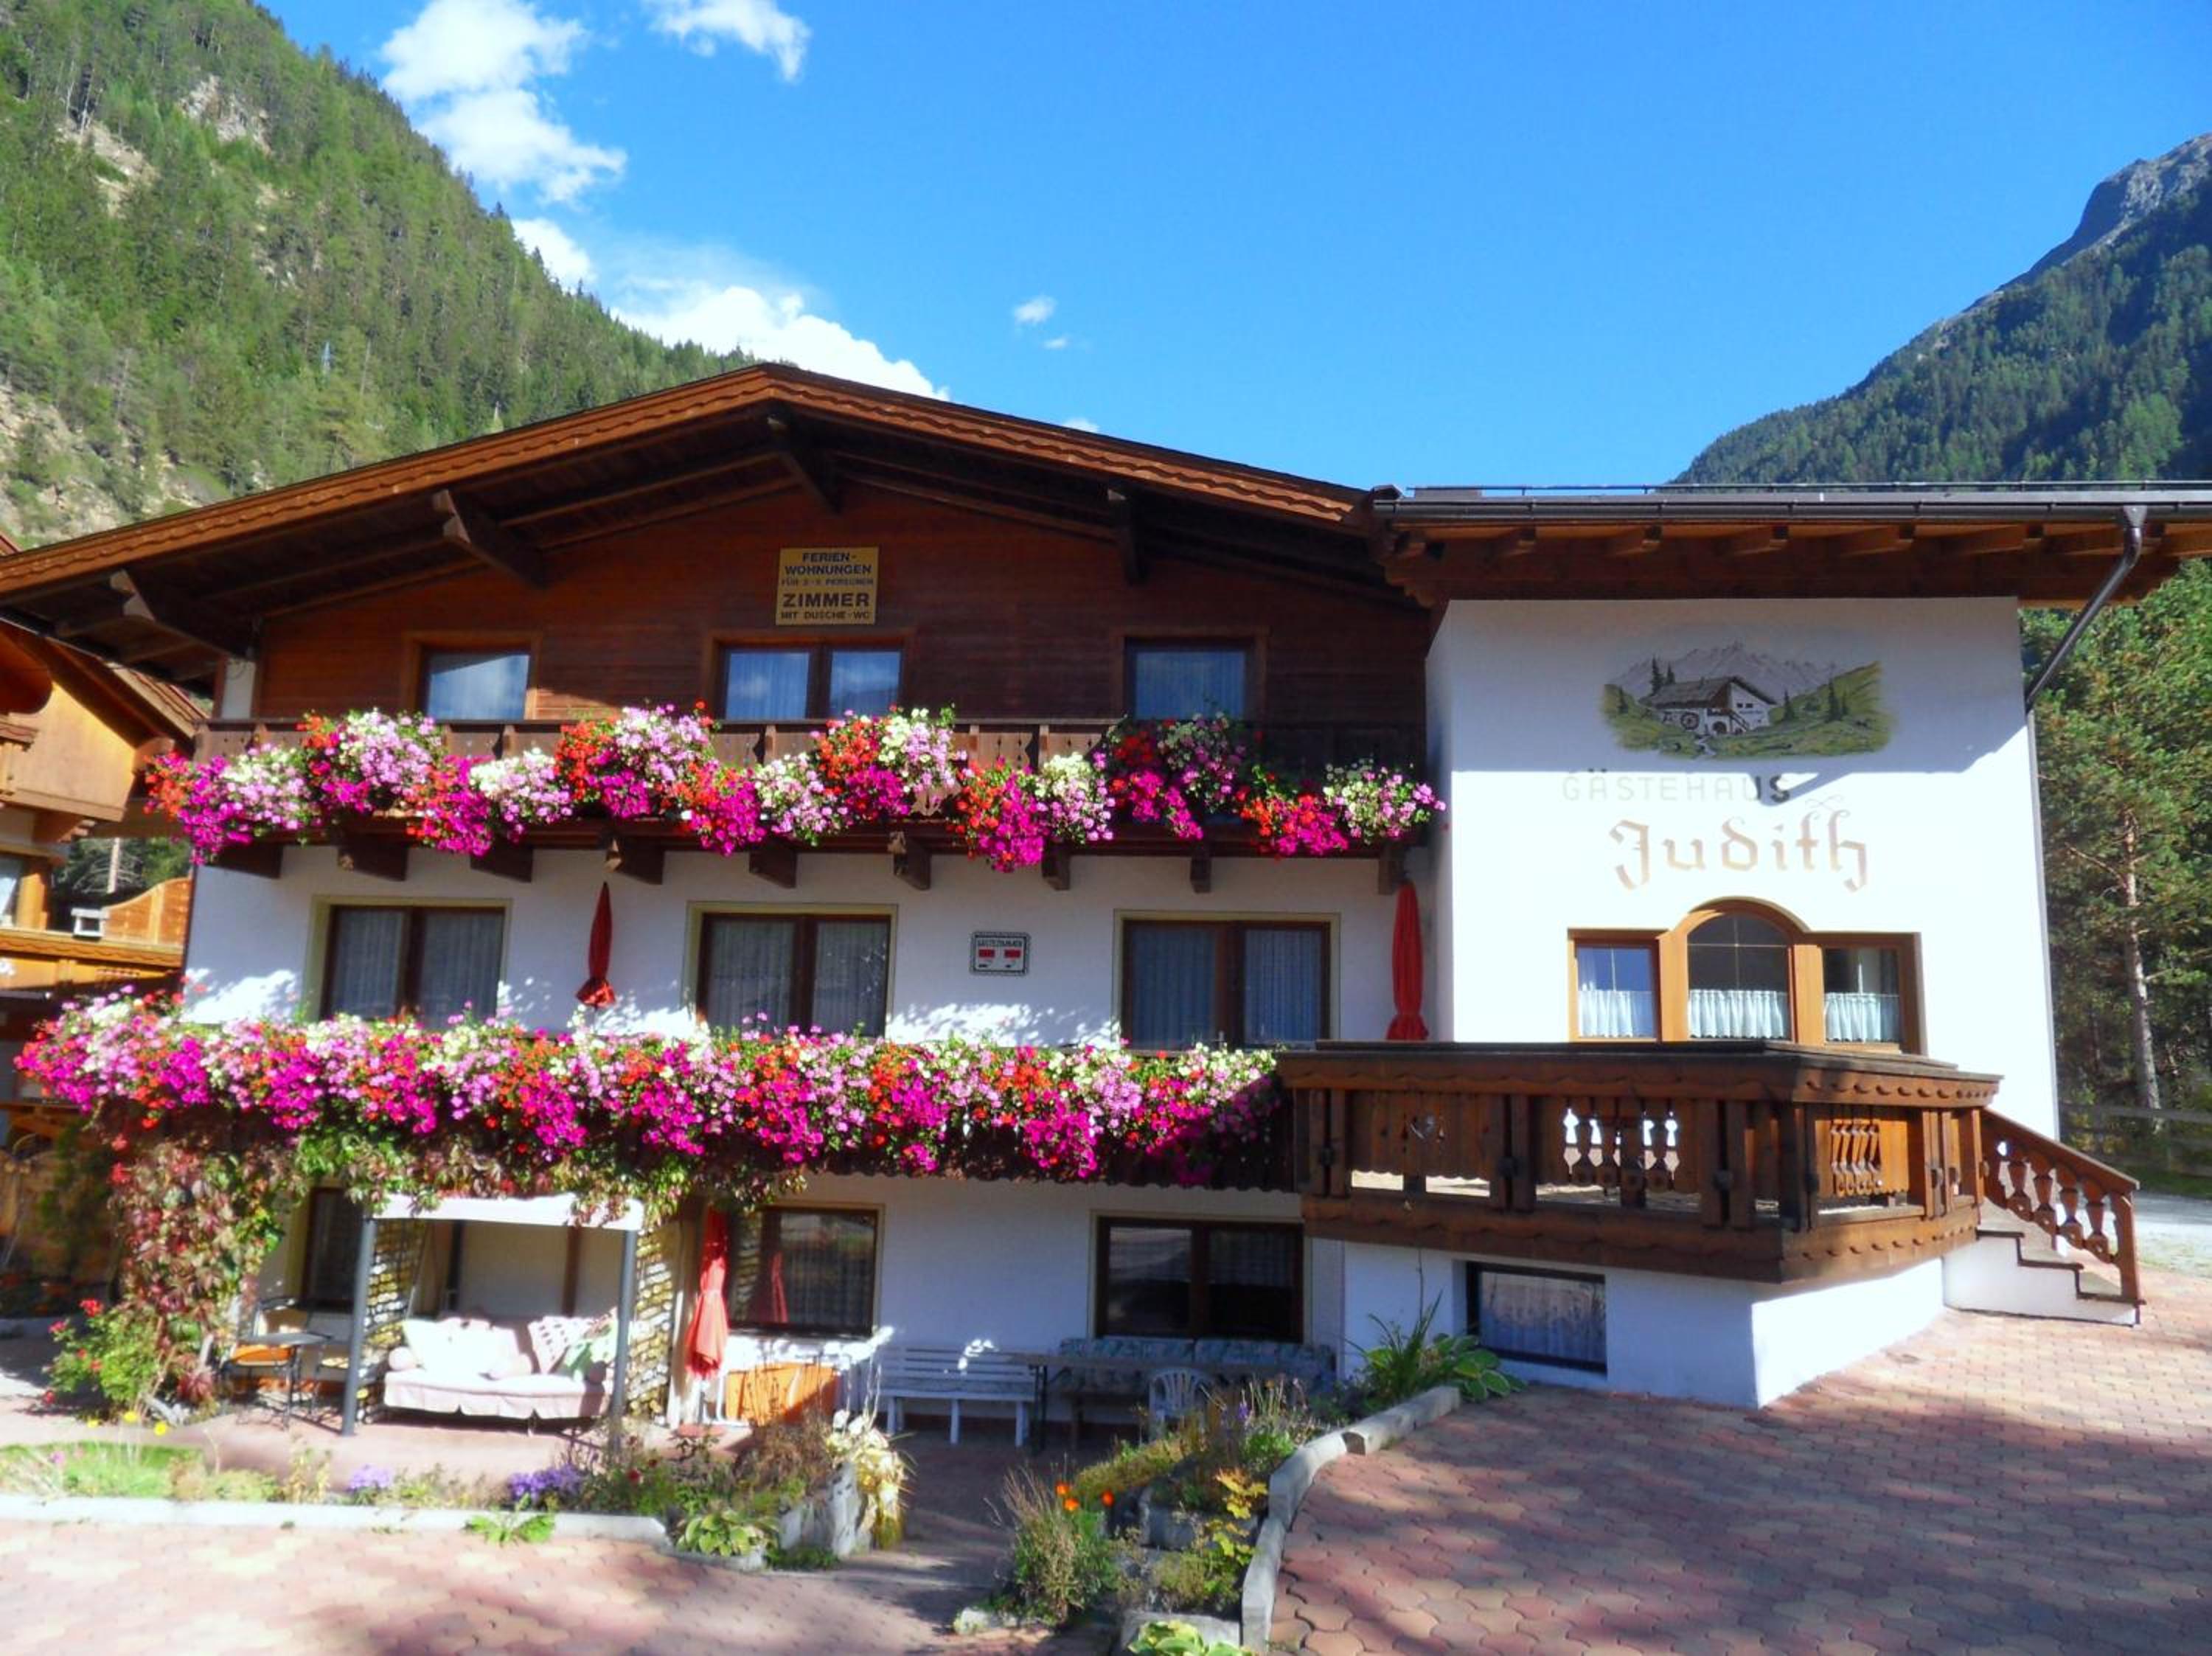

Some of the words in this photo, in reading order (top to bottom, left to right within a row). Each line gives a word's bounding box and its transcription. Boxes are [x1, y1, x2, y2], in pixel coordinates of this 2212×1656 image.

[802, 552, 858, 563] FERIEN-
[785, 564, 872, 574] WOHNUNGEN
[782, 593, 870, 608] ZIMMER
[1608, 808, 1868, 893] Judith
